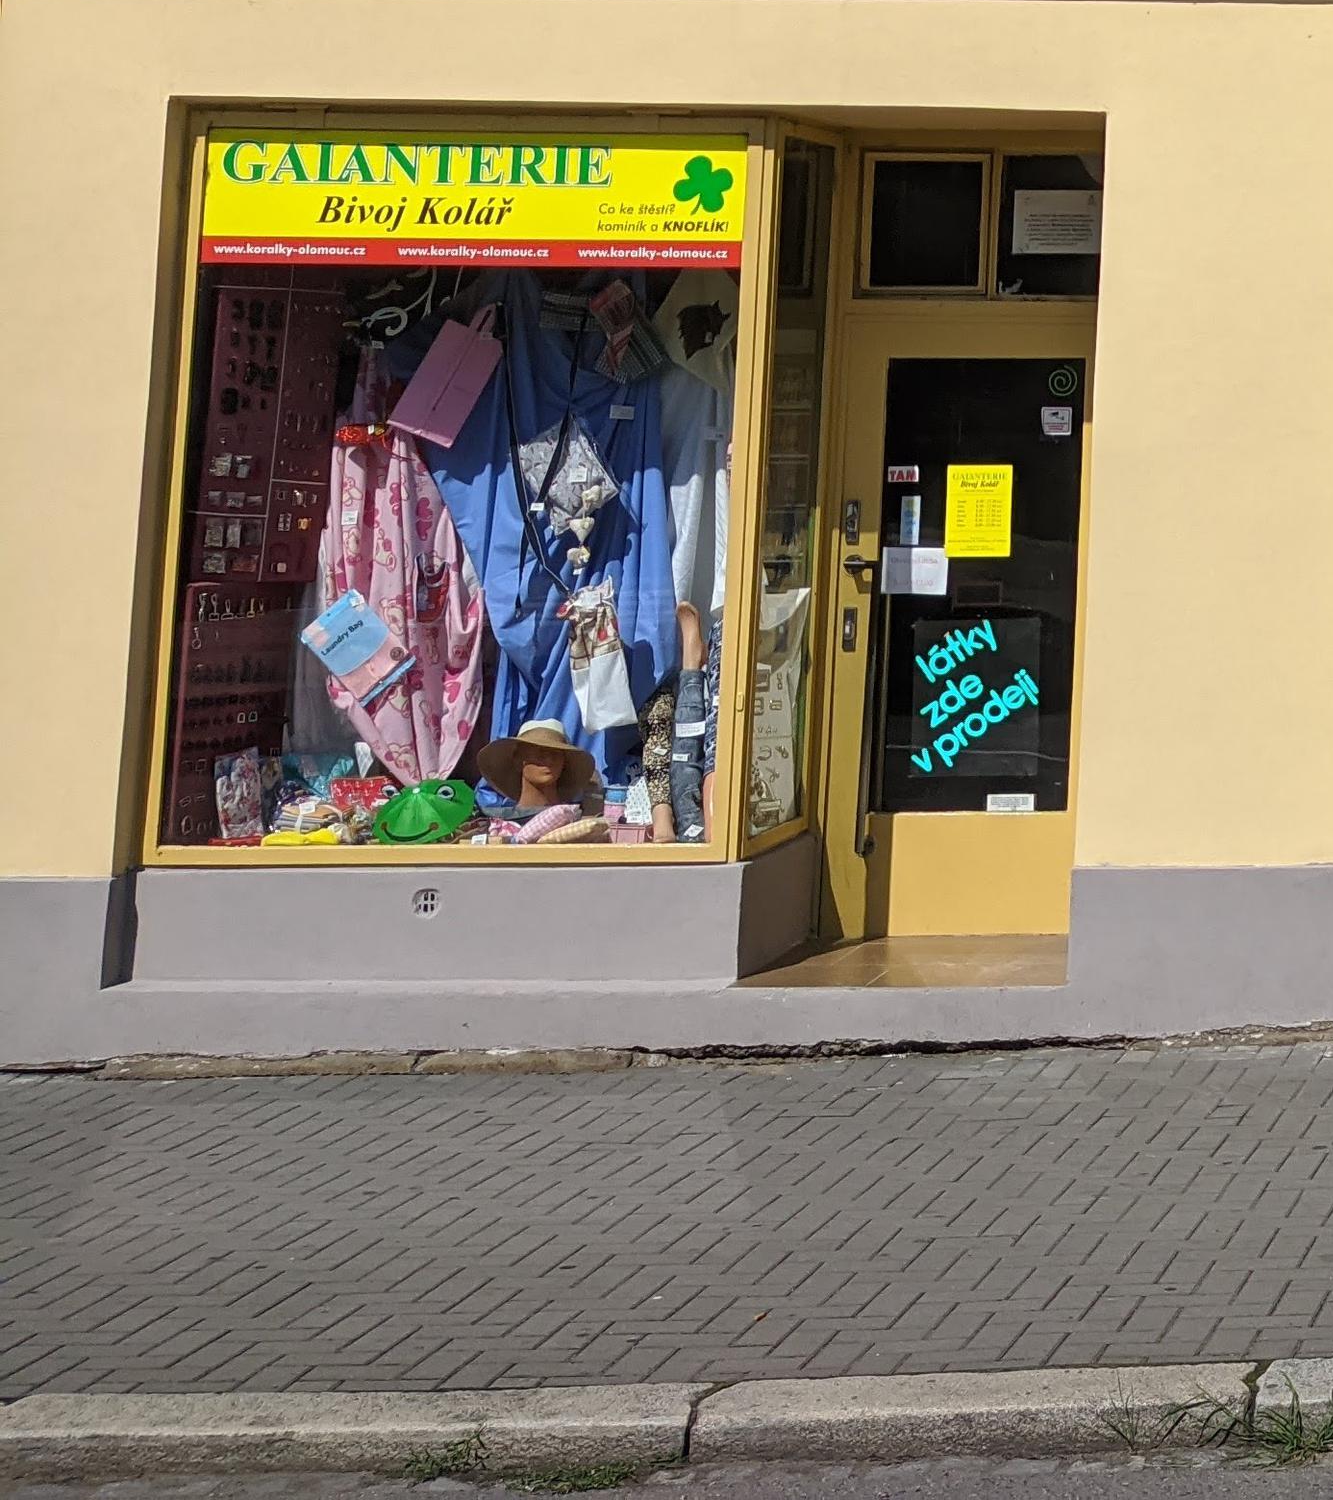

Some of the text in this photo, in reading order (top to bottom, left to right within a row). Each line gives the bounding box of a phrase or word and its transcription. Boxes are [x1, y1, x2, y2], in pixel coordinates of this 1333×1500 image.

[222, 139, 612, 187] GALANTERIE
[316, 195, 515, 233] Bivoj Kolář
[596, 219, 729, 233] kominík a KNOFLÍK!
[598, 202, 676, 216] Co ke štěstí?
[213, 242, 367, 257] www.koralky-olomouc.cz
[397, 244, 550, 259] www.koralky-olomouc.cz
[577, 246, 729, 261] www.koralky-olomouc.cz
[321, 619, 363, 656] Laundry Bag
[915, 619, 997, 683] látky
[920, 674, 984, 728] zde
[911, 668, 1040, 772] v prodeji
